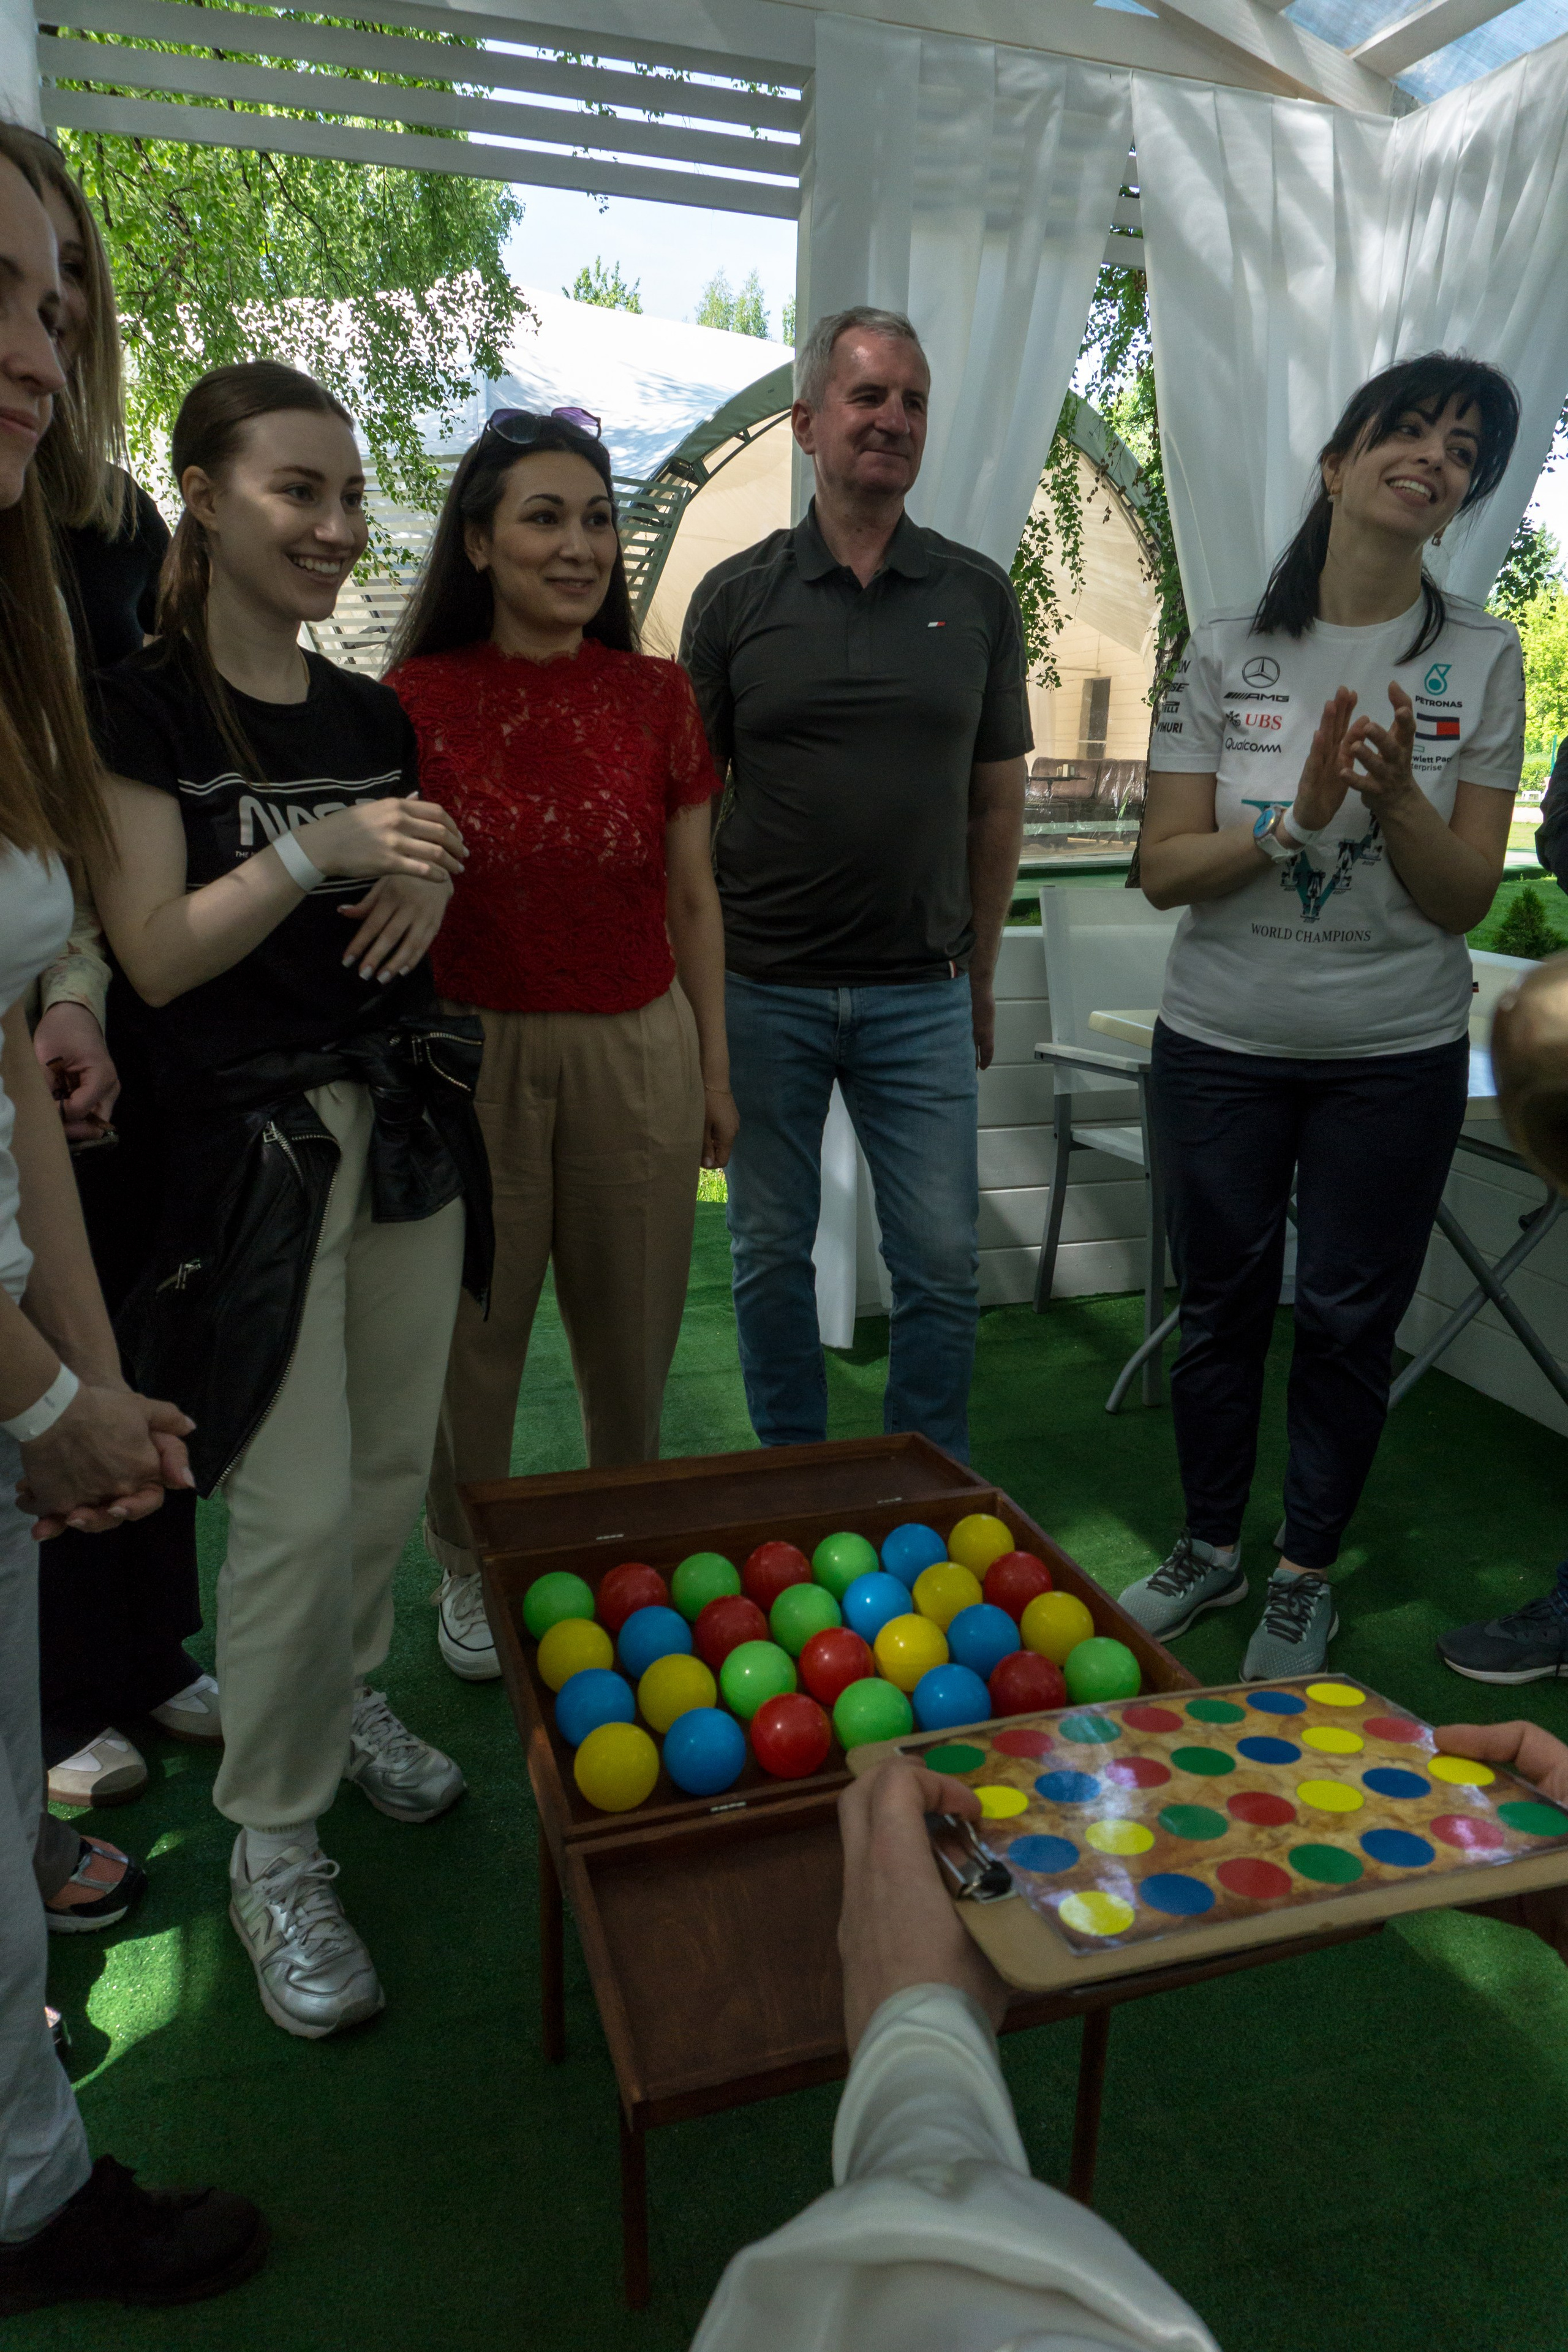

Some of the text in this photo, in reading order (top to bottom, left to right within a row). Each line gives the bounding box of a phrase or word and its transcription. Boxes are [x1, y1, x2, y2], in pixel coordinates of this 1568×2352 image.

[1170, 682, 1189, 692] SE
[1243, 692, 1289, 702] AMG
[1415, 695, 1463, 707] PETRONAS
[1245, 714, 1282, 730] UBS
[1225, 737, 1281, 753] Qualcomm
[1251, 923, 1371, 943] WORLD CHAMPIONS
